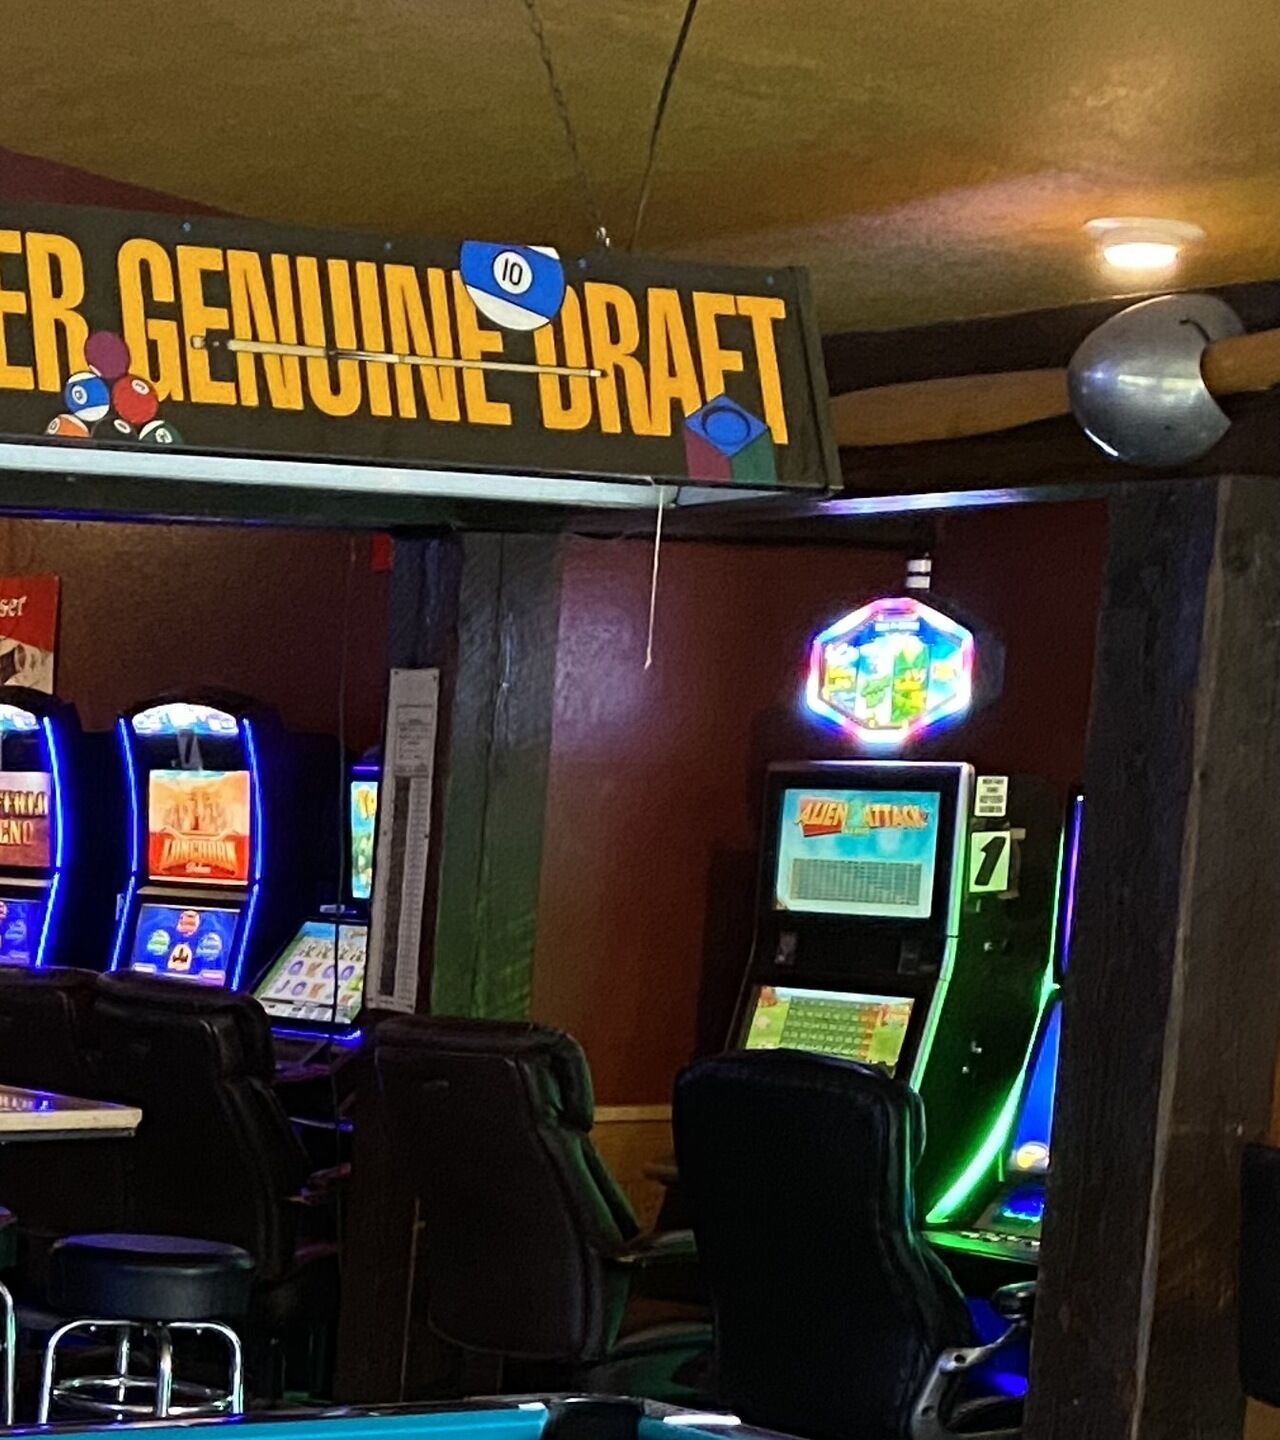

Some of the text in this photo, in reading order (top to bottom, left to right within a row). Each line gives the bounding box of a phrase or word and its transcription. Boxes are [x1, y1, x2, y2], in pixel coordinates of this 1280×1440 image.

[501, 263, 523, 286] 10
[117, 238, 512, 426] GENUINE
[533, 282, 789, 445] DRAFT
[797, 800, 926, 829] ALIEN ATTACK
[975, 836, 1007, 886] 1
